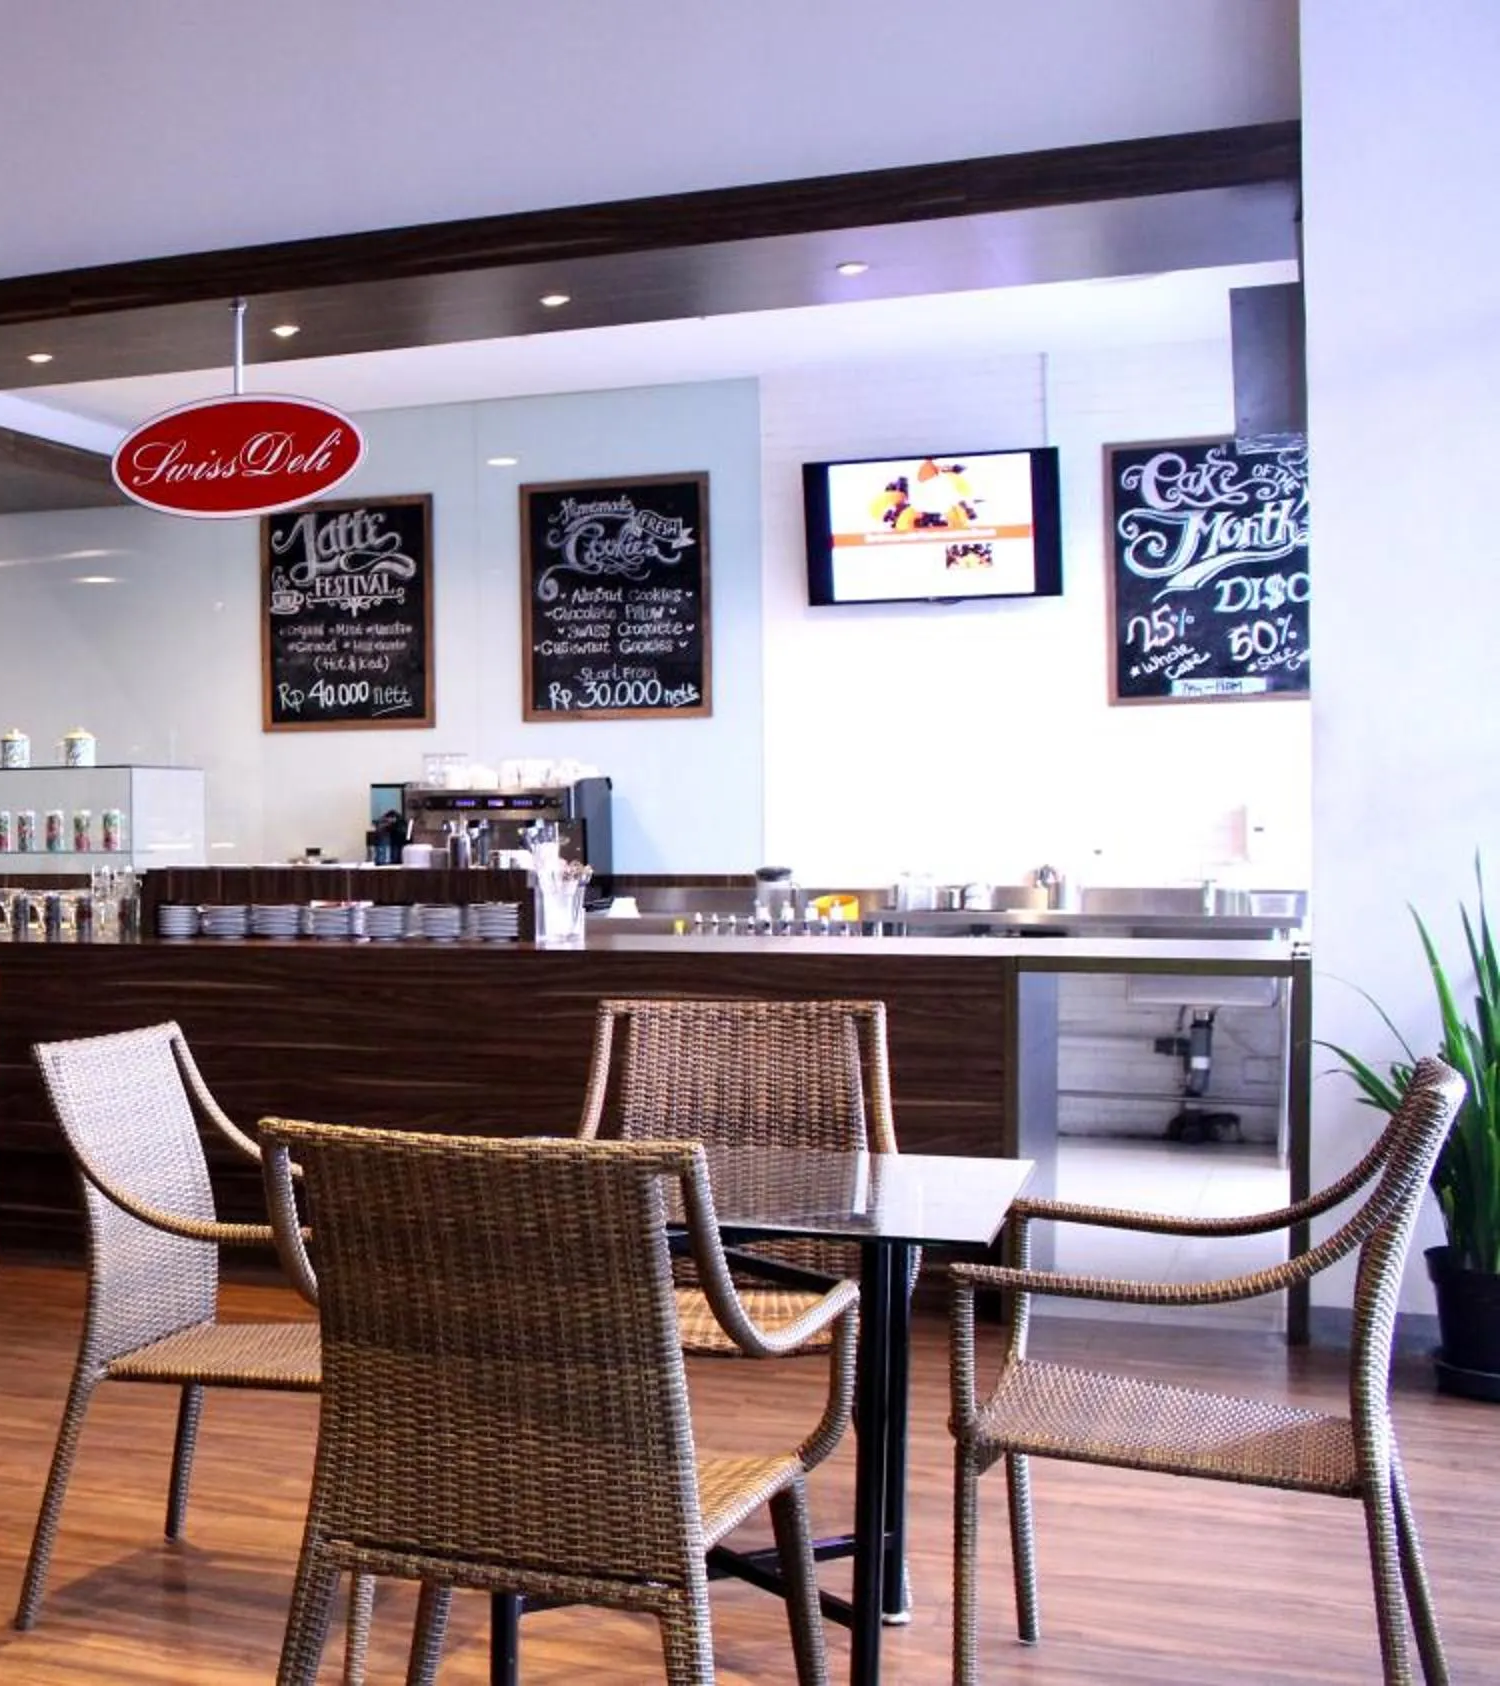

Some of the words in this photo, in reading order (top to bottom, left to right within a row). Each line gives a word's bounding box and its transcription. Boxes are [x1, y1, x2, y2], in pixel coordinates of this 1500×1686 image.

[132, 439, 240, 487] Swiss
[240, 428, 343, 477] Deli
[1122, 447, 1242, 510] Cake
[1252, 463, 1271, 477] OF
[639, 513, 680, 536] FRESH
[1118, 500, 1298, 578] Month
[271, 509, 403, 587] Latte
[548, 513, 670, 578] Cookies
[315, 573, 395, 597] FESTIVAL
[628, 587, 682, 602] Cookies
[551, 605, 617, 620] Chocolate
[619, 637, 673, 654] Cookies
[1228, 614, 1297, 661] 50%
[574, 663, 620, 681] Start
[1142, 643, 1195, 675] Whole
[1164, 652, 1212, 680] Cake
[278, 682, 305, 713] Rp
[309, 677, 370, 708] 40.000
[549, 681, 573, 710] Rp
[577, 679, 662, 708] 30.000
